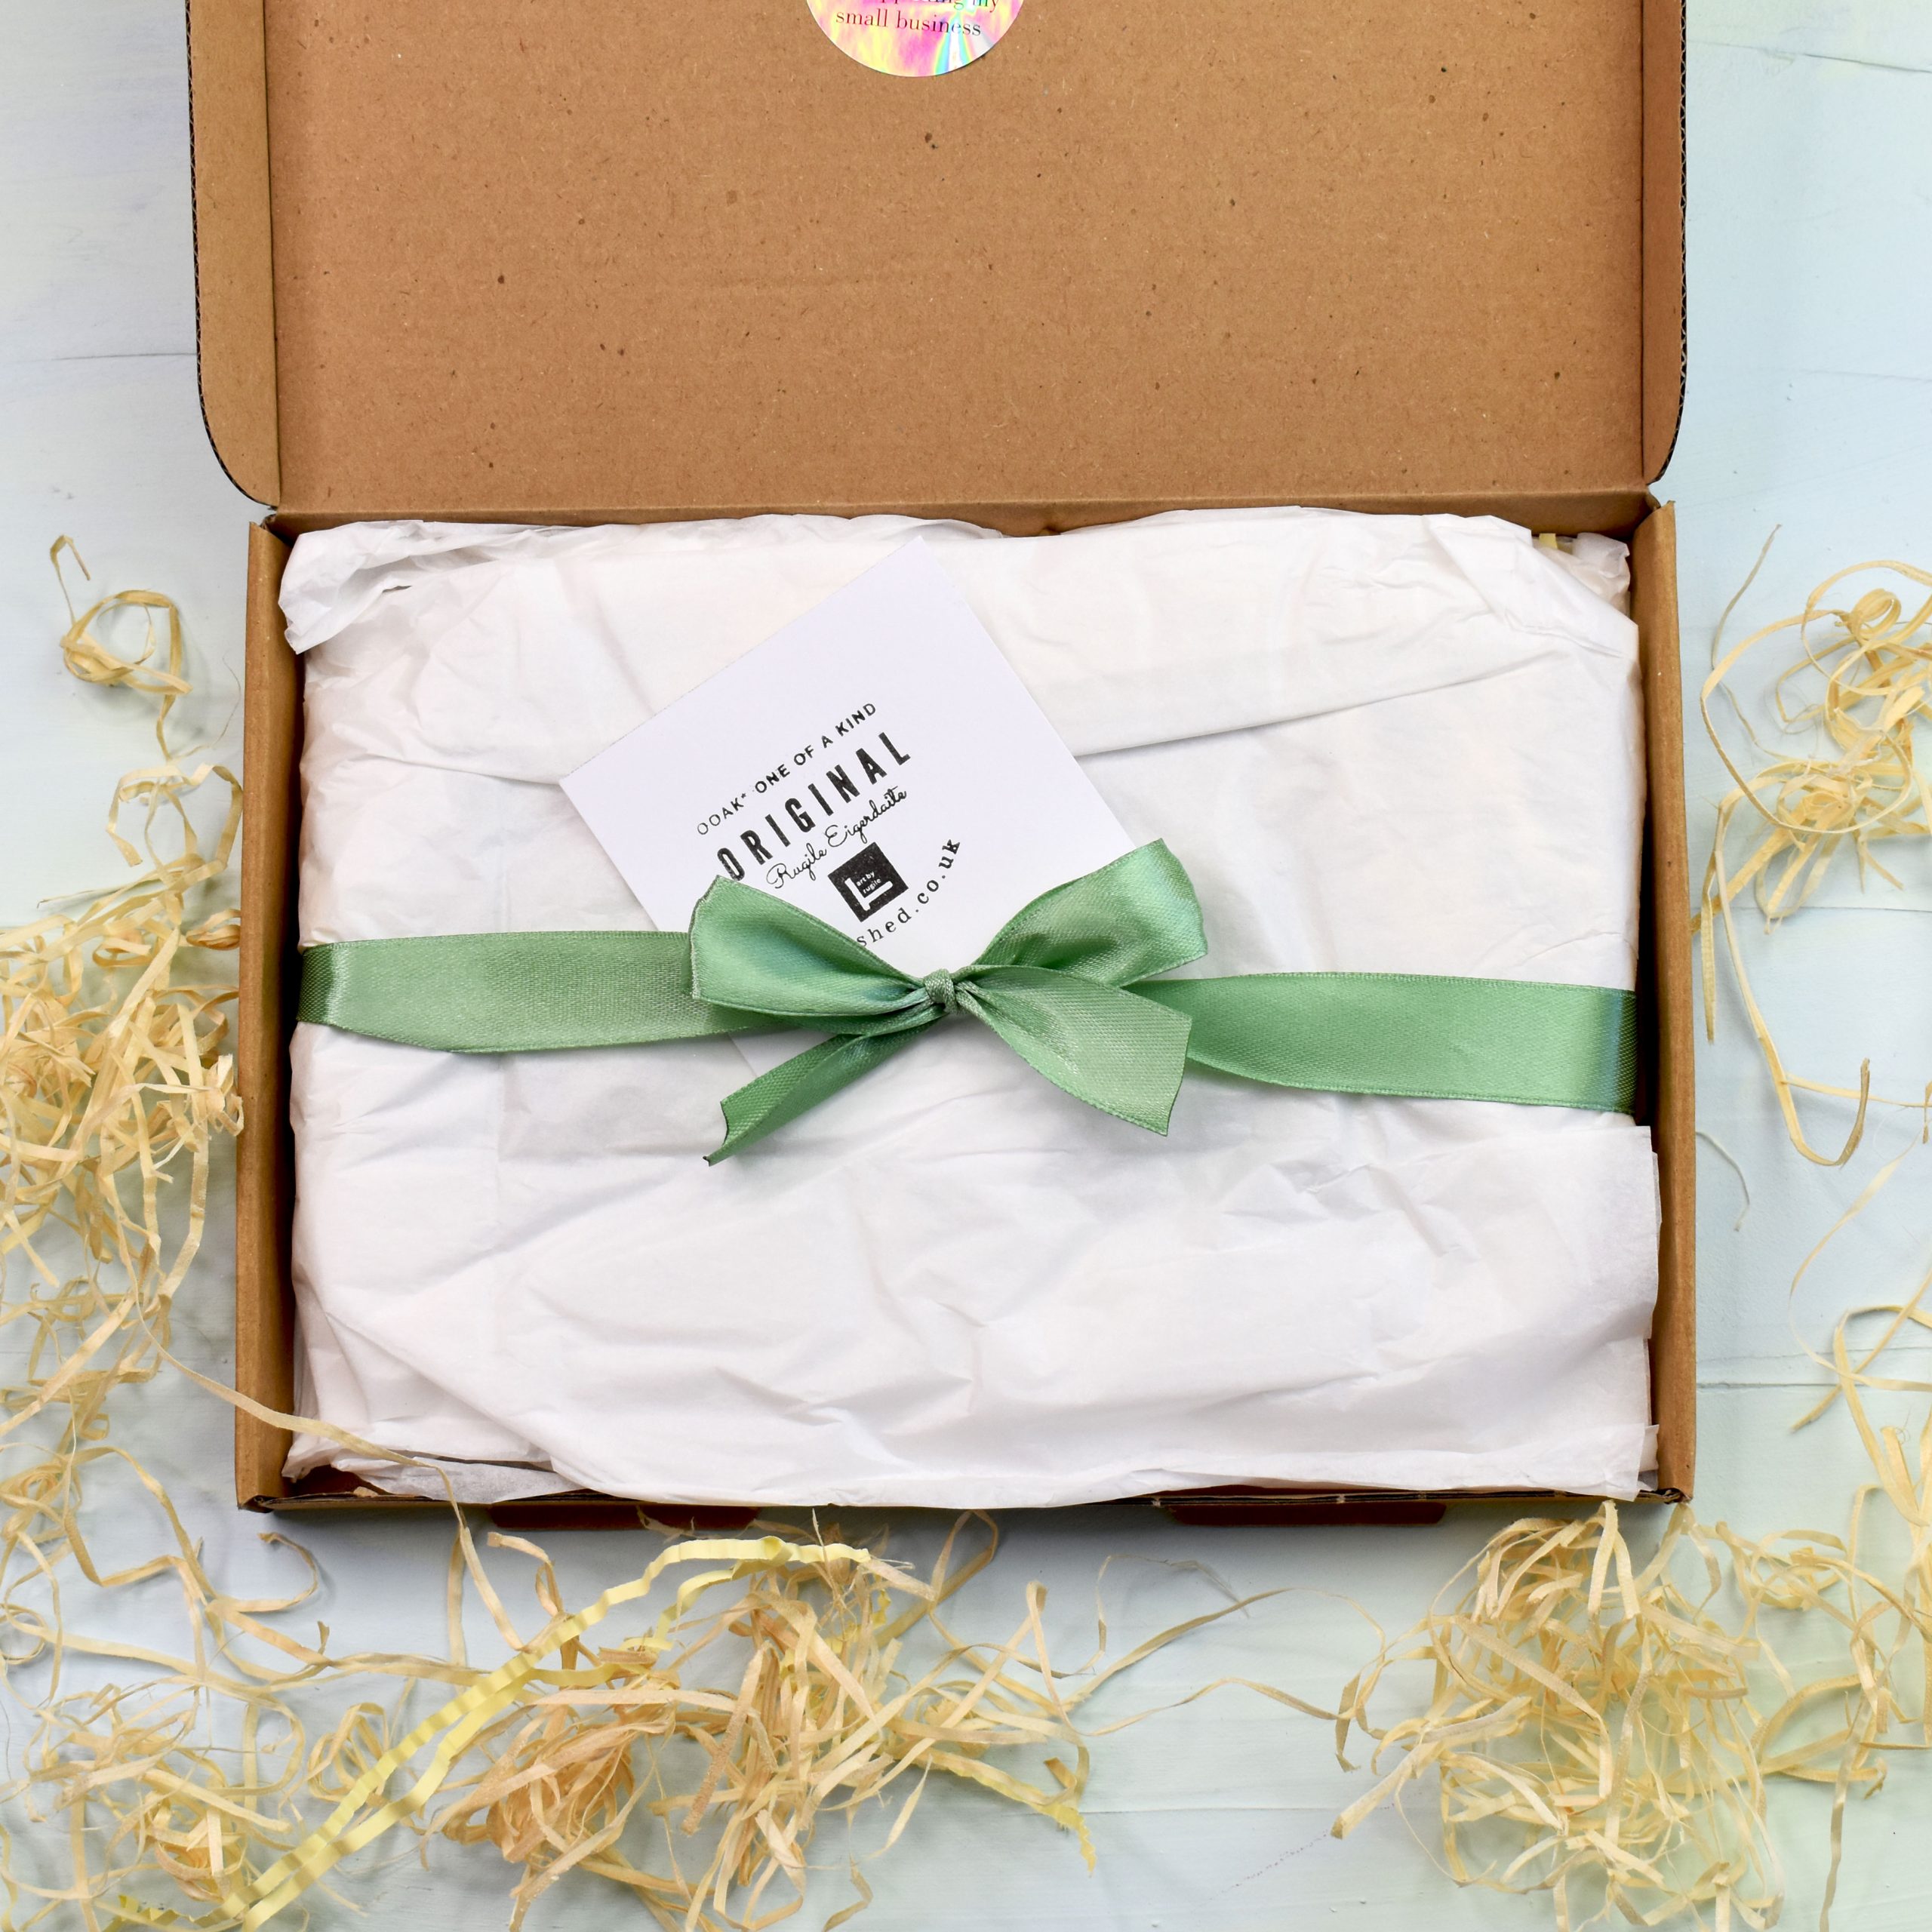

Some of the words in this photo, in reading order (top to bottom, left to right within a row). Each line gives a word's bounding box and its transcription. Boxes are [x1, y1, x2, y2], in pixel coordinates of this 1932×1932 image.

[835, 8, 888, 27] small
[896, 9, 982, 36] business
[755, 764, 790, 794] ONE
[793, 744, 815, 766] OF
[821, 735, 834, 749] A
[835, 703, 876, 737] KIND
[716, 732, 911, 881] ORIGINAL
[766, 842, 827, 889] Rugile
[824, 785, 907, 844] Eigerdaite
[856, 877, 867, 887] art
[865, 871, 875, 879] by
[863, 878, 881, 894] rugile
